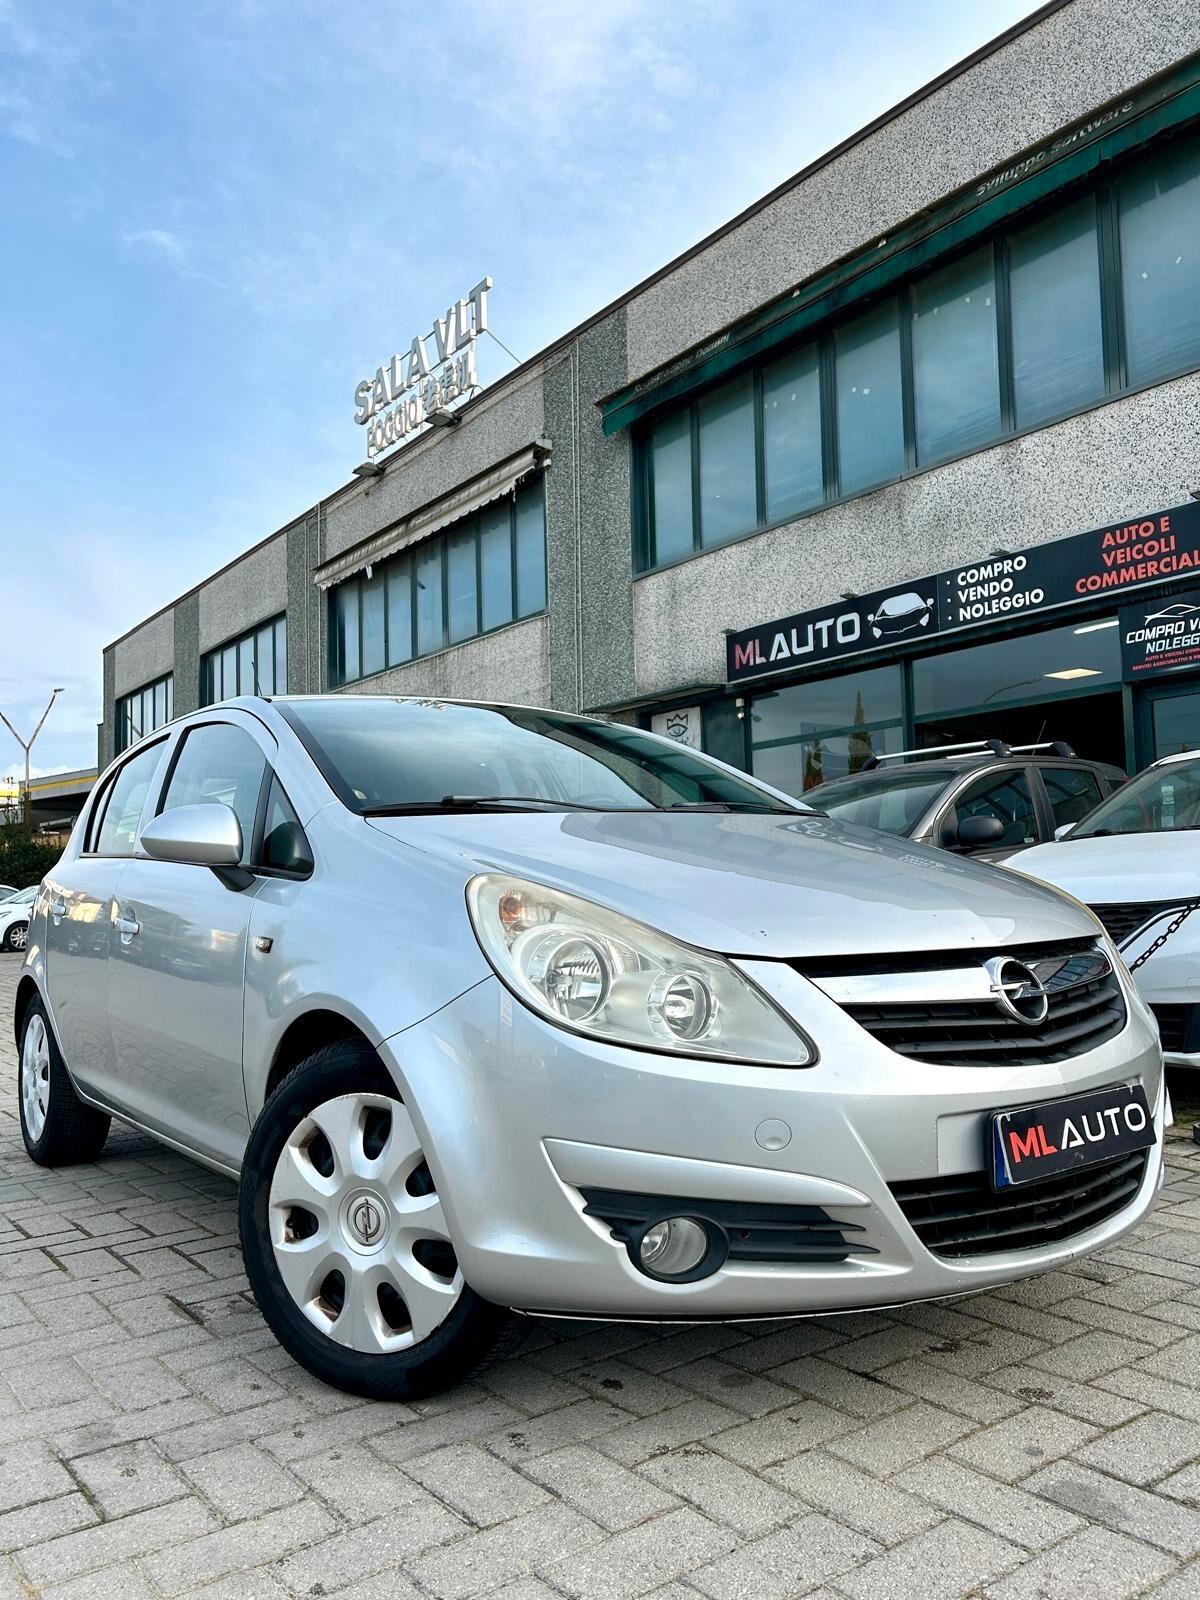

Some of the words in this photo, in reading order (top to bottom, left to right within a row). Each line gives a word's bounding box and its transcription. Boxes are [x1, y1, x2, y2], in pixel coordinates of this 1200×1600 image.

[354, 335, 431, 425] SALA
[433, 275, 493, 362] VLT
[367, 394, 424, 458] POGGIO
[1102, 521, 1155, 548] AUTO
[1160, 516, 1170, 532] E
[1102, 535, 1176, 567] VEICOLI
[957, 555, 1027, 586] COMPRO
[957, 578, 1014, 603] VENDO
[959, 588, 1044, 621] NOLEGGIO
[769, 612, 861, 661] AUTO
[1126, 621, 1185, 644] COMPRO
[1190, 618, 1200, 631] V
[1146, 633, 1200, 654] NOLEGG
[1009, 1125, 1058, 1164] ML
[1060, 1102, 1147, 1150] AUTO
